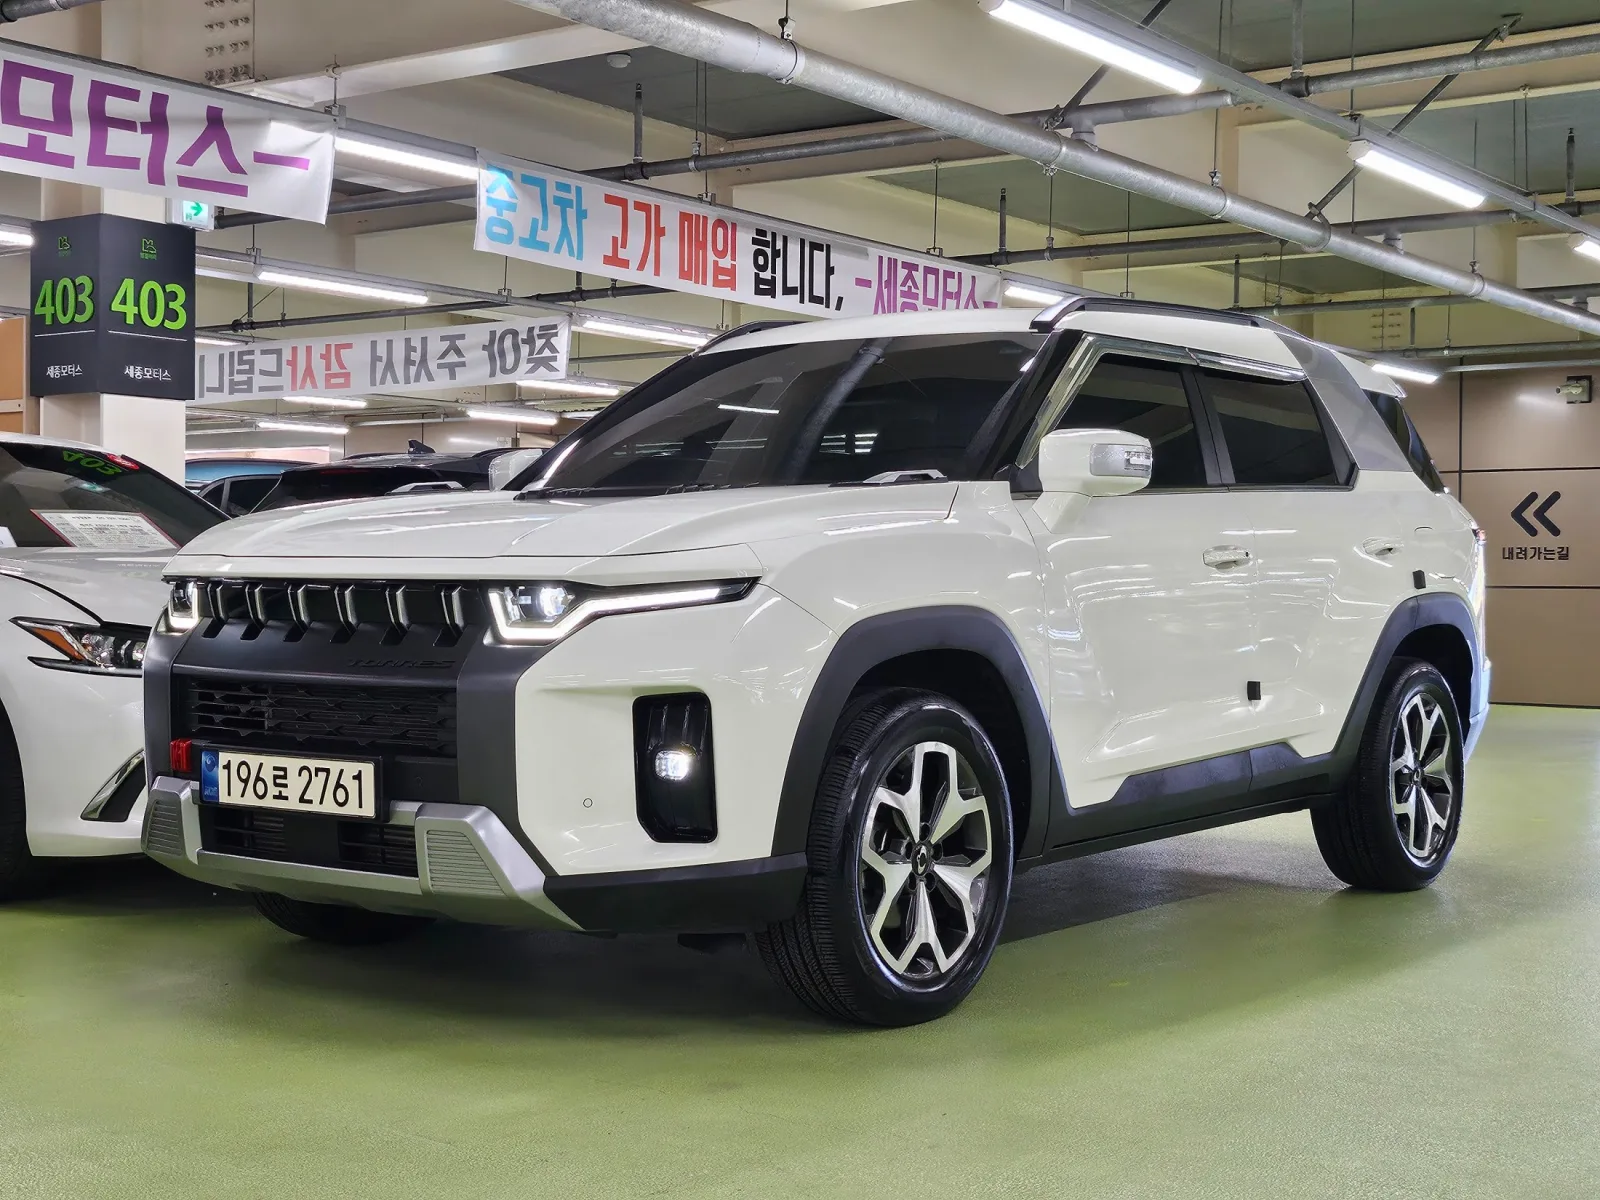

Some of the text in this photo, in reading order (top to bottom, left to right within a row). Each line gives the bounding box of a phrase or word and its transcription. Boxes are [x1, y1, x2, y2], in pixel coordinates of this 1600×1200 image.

[485, 163, 588, 261] 중고차
[603, 193, 666, 277] 고가
[678, 210, 738, 292] 매입
[751, 228, 844, 312] 합니다,
[34, 275, 95, 326] 403
[110, 278, 188, 331] 403
[46, 364, 83, 379] 세종모터스
[124, 365, 172, 381] 세종모터스
[1502, 546, 1570, 561] 내려가는길
[221, 759, 364, 809] 196로 2761
